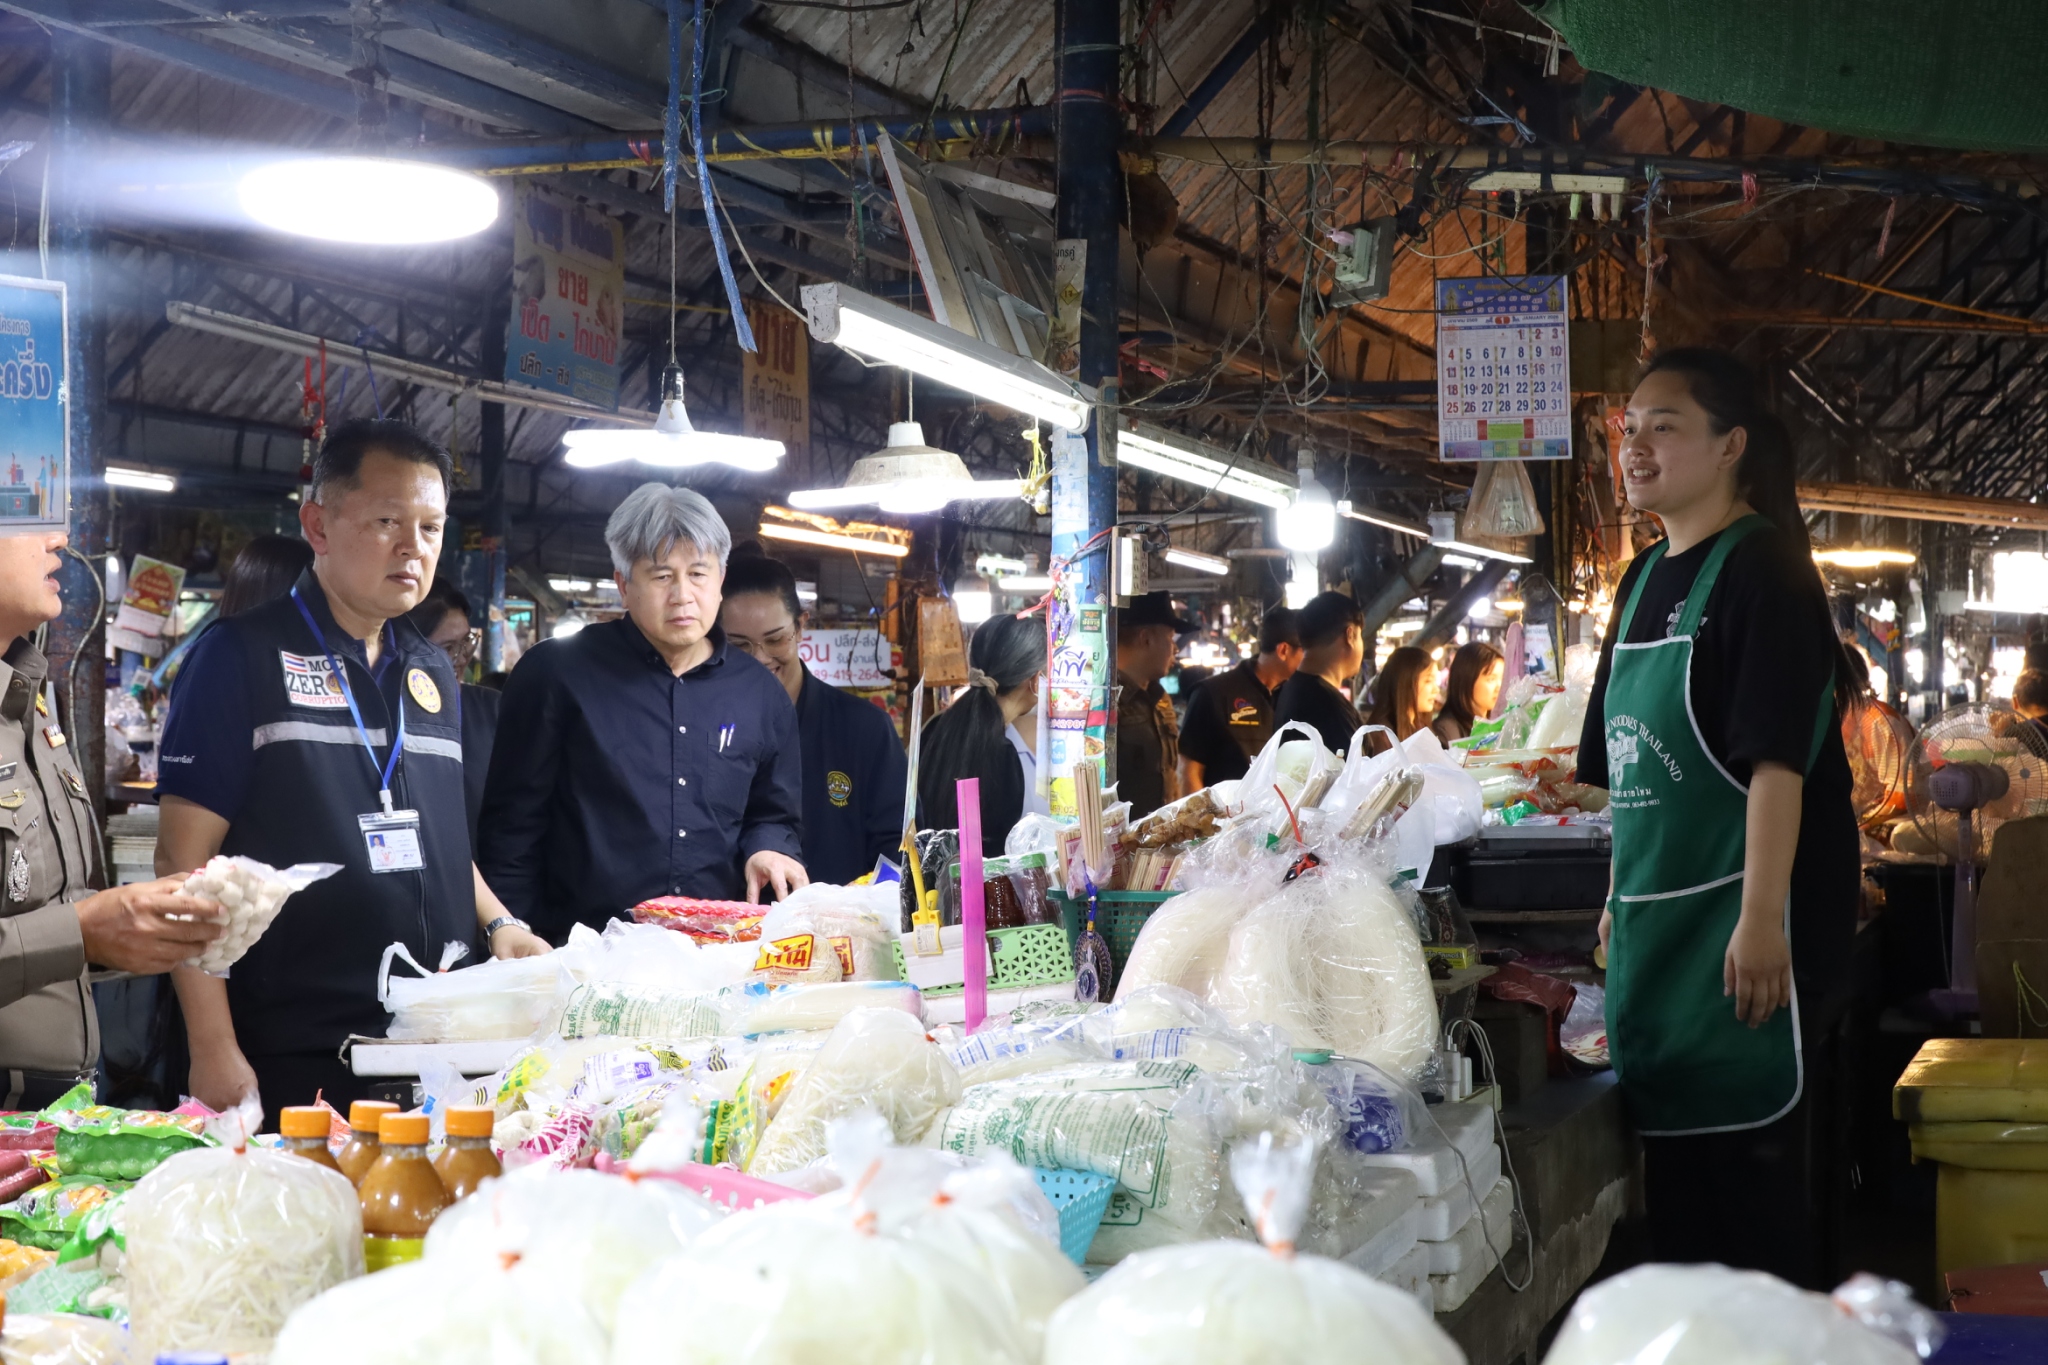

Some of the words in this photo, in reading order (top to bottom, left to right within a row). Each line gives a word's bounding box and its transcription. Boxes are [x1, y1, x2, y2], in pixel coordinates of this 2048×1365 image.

[558, 267, 588, 306] ขาย
[521, 298, 550, 343] เป็ด
[573, 312, 616, 366] ไก่บ้าน
[1518, 329, 1523, 340] 1
[1535, 328, 1541, 339] 2
[1552, 328, 1559, 339] 3
[1448, 349, 1454, 359] 4
[1465, 348, 1472, 359] 5
[1483, 348, 1489, 358] 6
[1500, 347, 1506, 358] 7
[1518, 347, 1524, 357] 8
[1536, 346, 1542, 357] 9
[1550, 346, 1562, 356] 10
[1446, 367, 1456, 378] 11
[1464, 367, 1475, 377] 12
[1481, 366, 1493, 376] 13
[1498, 365, 1510, 376] 14
[1516, 364, 1528, 375] 15
[1534, 364, 1545, 374] 16
[1551, 364, 1562, 374] 17
[1447, 385, 1458, 395] 18
[1464, 384, 1476, 395] 19
[1481, 383, 1493, 394] 20
[1498, 383, 1509, 394] 21
[1516, 382, 1528, 393] 22
[1534, 382, 1545, 392] 23
[1551, 381, 1563, 392] 24
[1447, 402, 1459, 413] 25
[1464, 402, 1476, 412] 26
[1482, 401, 1493, 412] 27
[1499, 400, 1511, 411] 28
[1517, 400, 1528, 411] 29
[1534, 399, 1546, 410] 30
[1551, 399, 1562, 410] 31
[308, 660, 344, 672] MOC
[291, 692, 348, 705] CORRUPTIO
[1610, 714, 1638, 731] NOODLES
[1639, 722, 1683, 782] THAILAND
